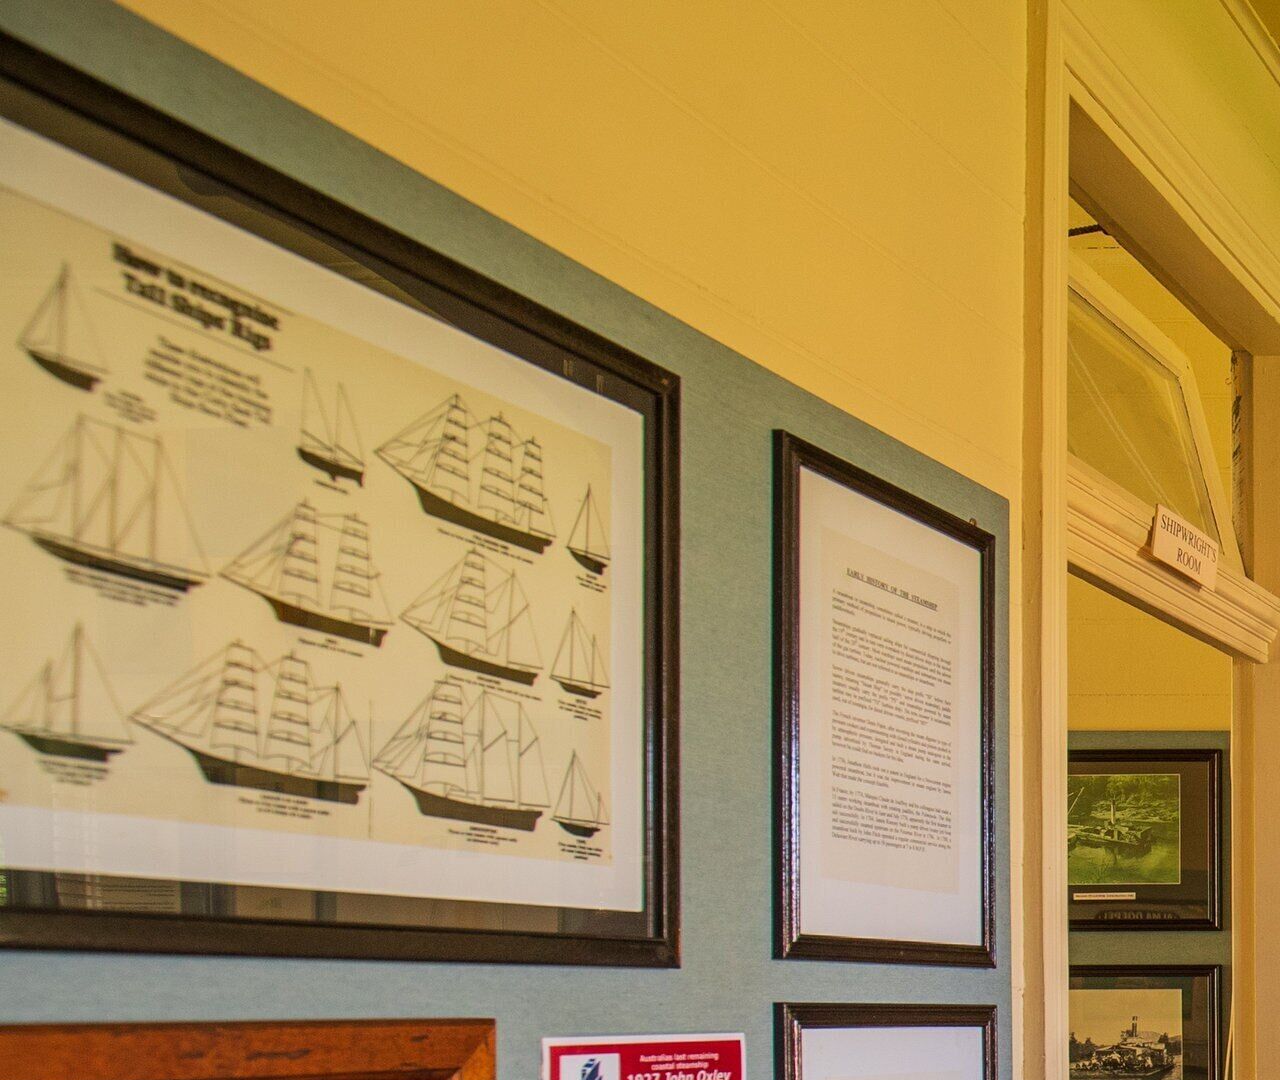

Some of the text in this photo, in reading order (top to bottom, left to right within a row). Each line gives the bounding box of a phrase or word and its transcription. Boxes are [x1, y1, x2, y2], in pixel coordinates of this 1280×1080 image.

[122, 271, 166, 305] Tall
[1160, 514, 1217, 563] SHIPWRIGHT'S
[1176, 547, 1201, 575] ROOM
[651, 1061, 709, 1071] coastal steamship
[674, 1053, 686, 1061] last
[687, 1052, 719, 1061] remaining
